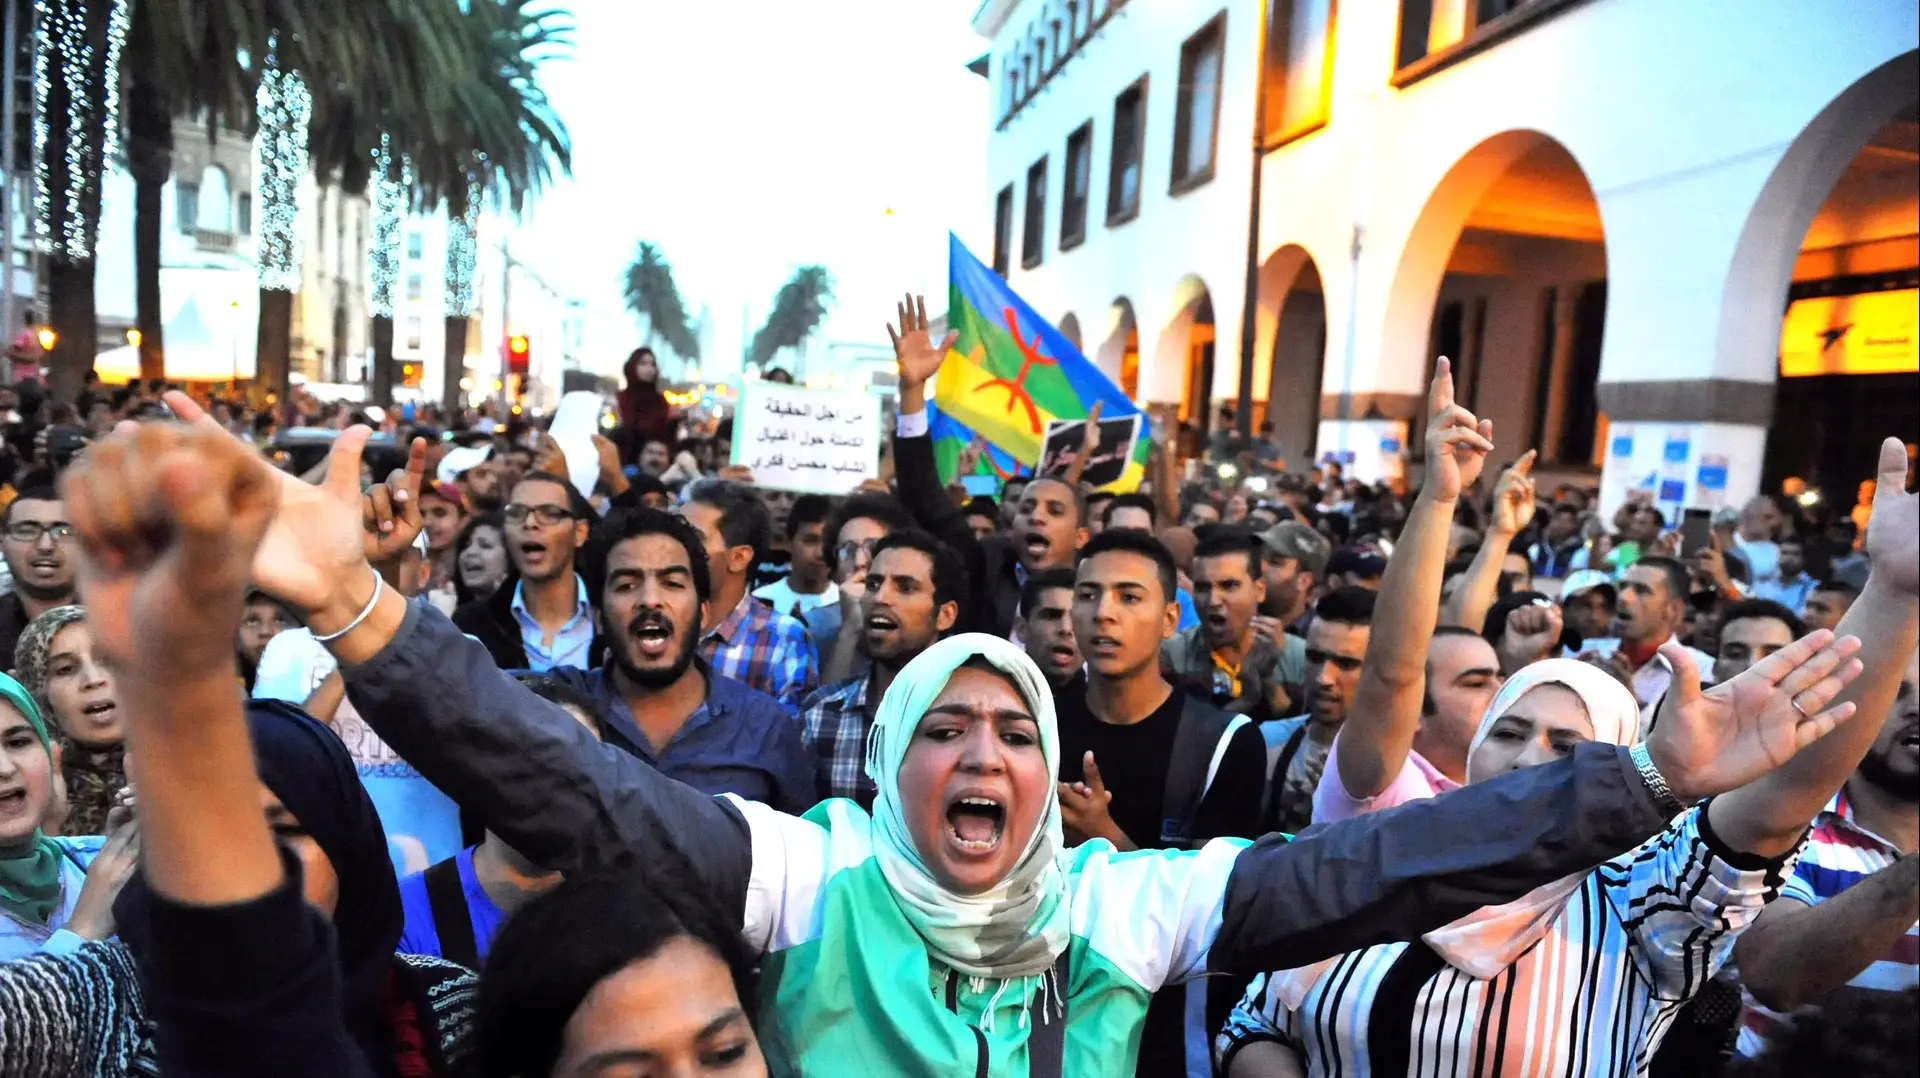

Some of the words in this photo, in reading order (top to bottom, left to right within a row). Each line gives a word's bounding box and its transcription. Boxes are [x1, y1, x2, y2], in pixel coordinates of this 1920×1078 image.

[765, 396, 812, 418] الحقيقة
[844, 412, 863, 424] من
[756, 426, 796, 444] اغتيال
[800, 430, 824, 446] حول
[829, 431, 865, 447] الكاملة
[751, 452, 784, 469] فكري
[788, 456, 827, 471] محسن
[832, 460, 867, 475] الشاب
